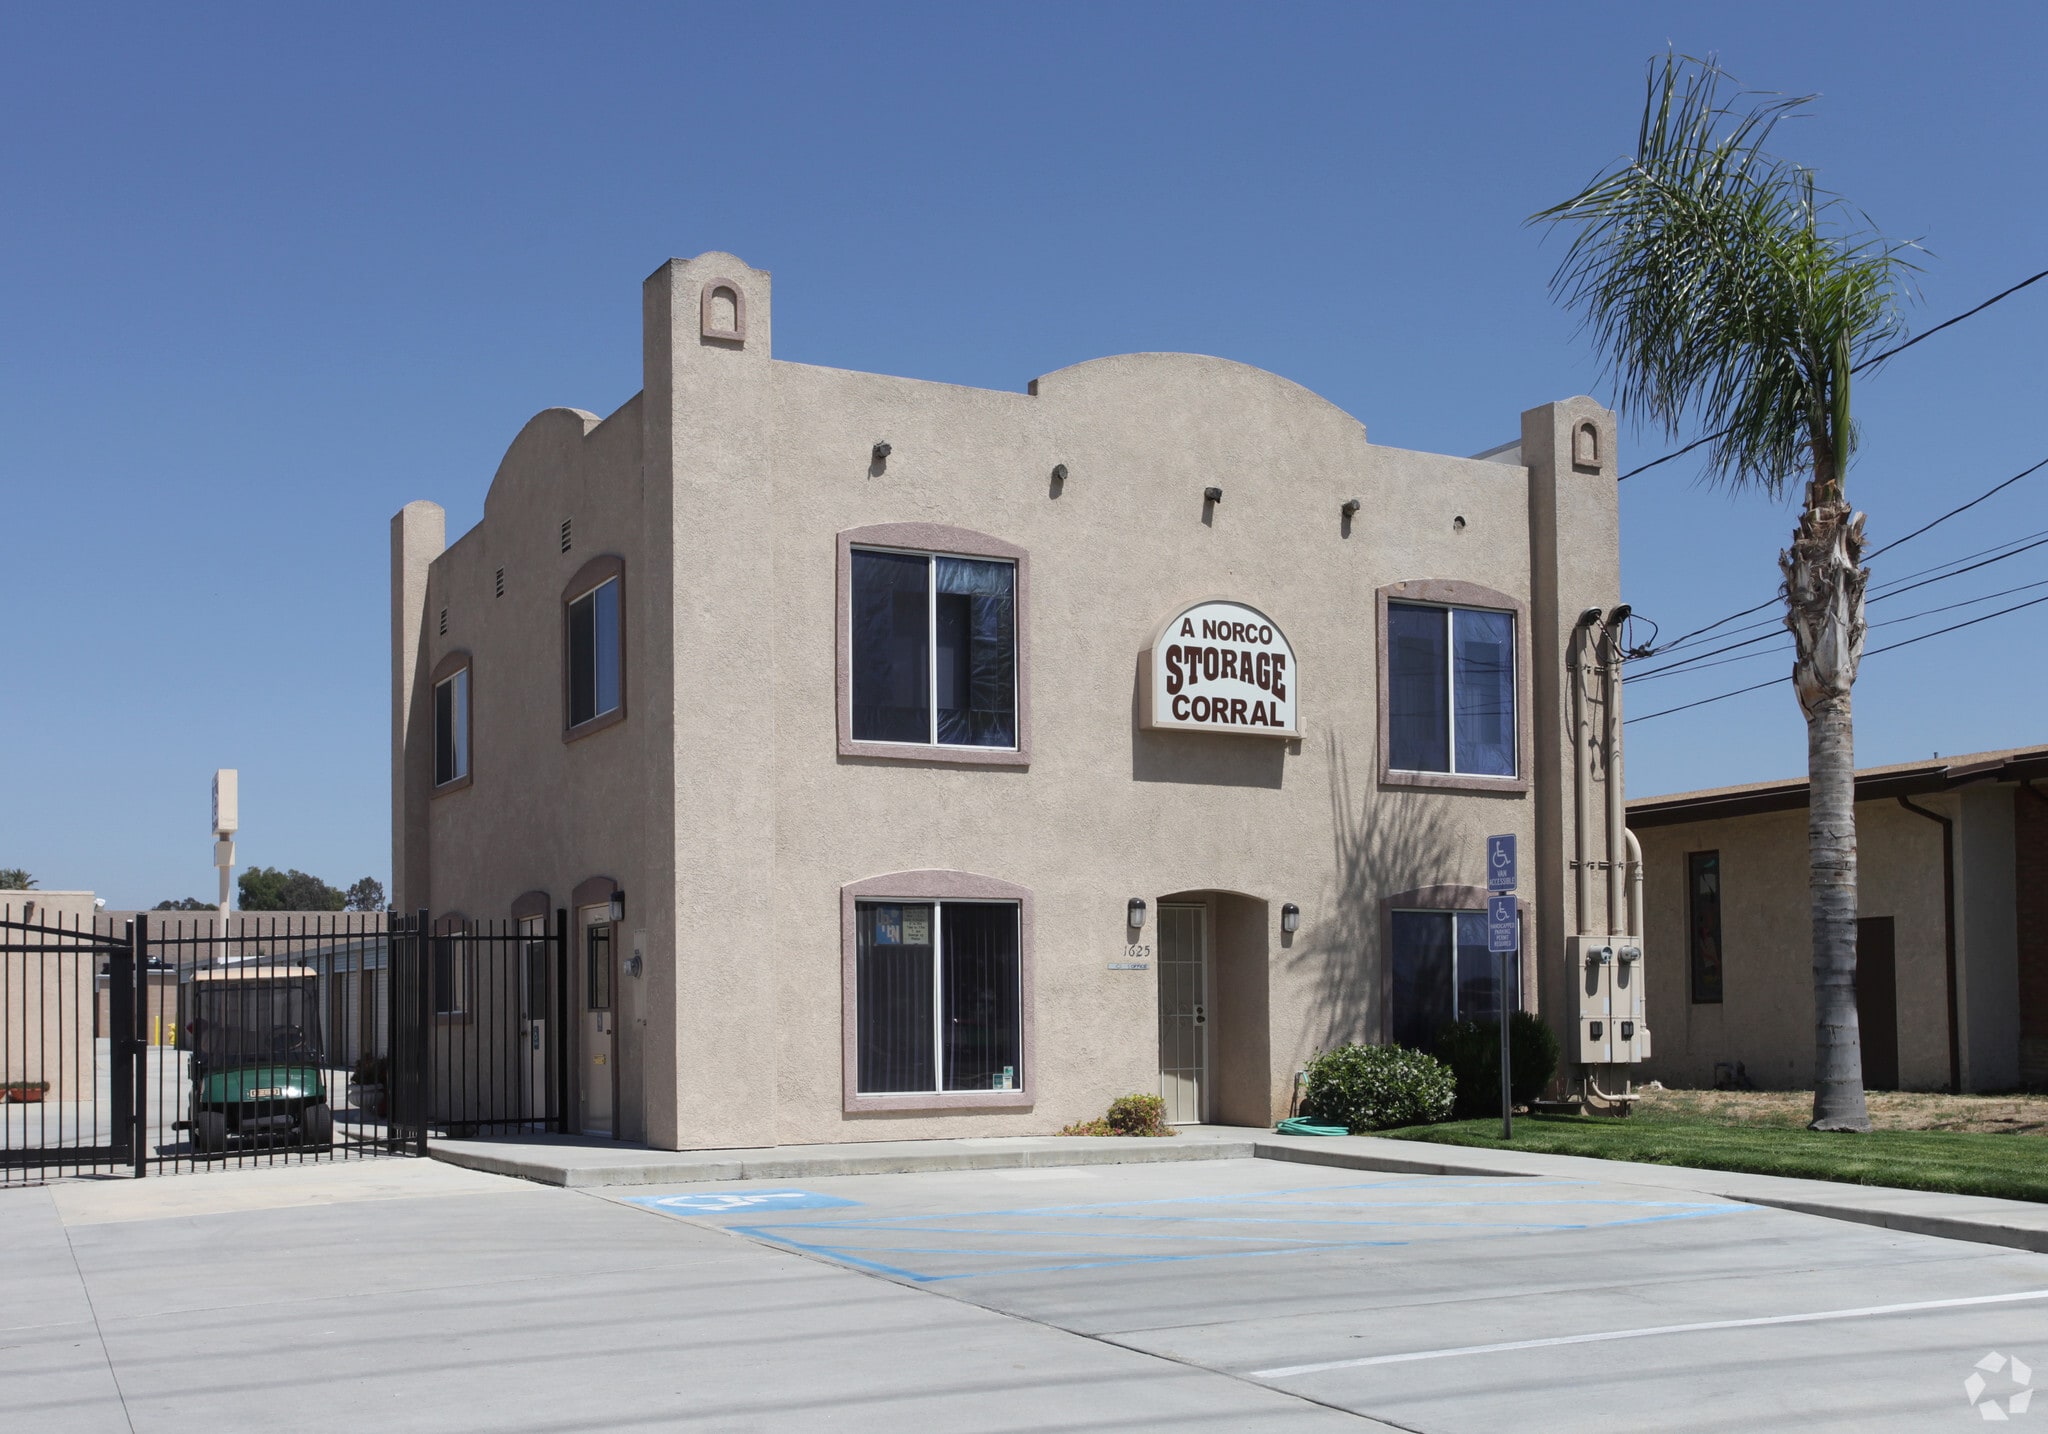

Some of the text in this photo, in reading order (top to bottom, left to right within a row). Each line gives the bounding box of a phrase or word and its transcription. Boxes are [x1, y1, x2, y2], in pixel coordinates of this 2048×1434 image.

[1180, 617, 1273, 645] A NORCO
[1165, 644, 1286, 703] STORAGE
[1172, 694, 1285, 728] CORRAL
[1489, 877, 1515, 886] ACCESSIBLE
[1497, 869, 1507, 877] VAN
[1123, 944, 1150, 957] 1625
